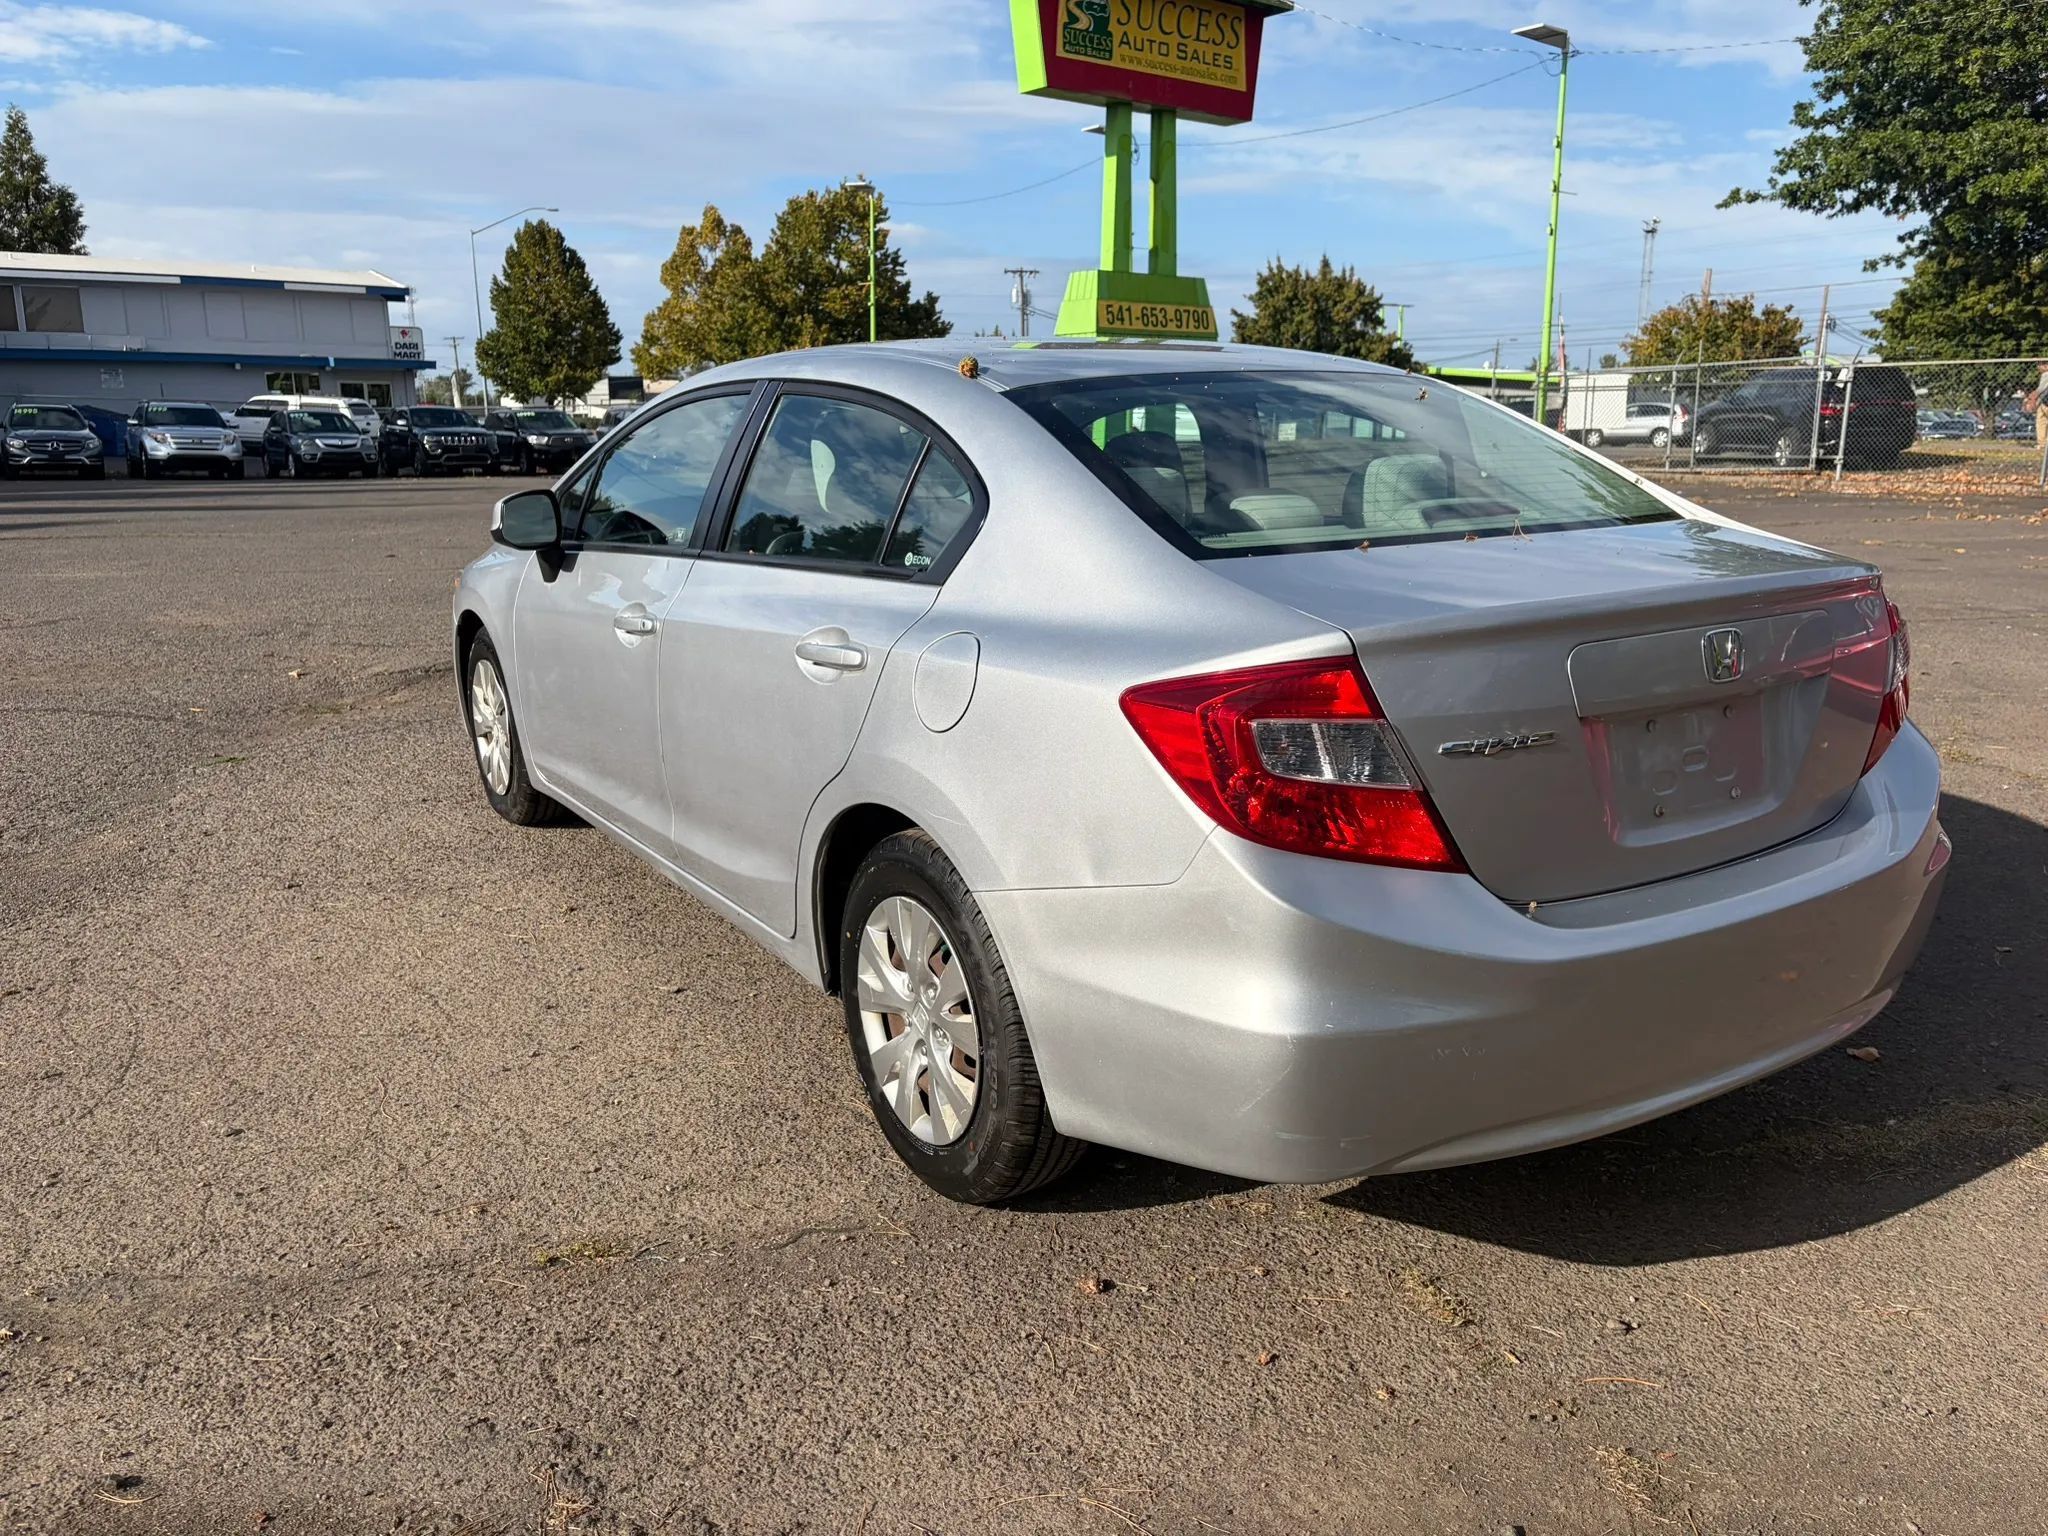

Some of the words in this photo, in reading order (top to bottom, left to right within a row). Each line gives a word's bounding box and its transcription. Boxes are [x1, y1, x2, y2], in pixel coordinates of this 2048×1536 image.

[1116, 0, 1242, 49] SUCCESS
[1064, 28, 1112, 51] SUCCESS
[1065, 43, 1086, 55] AUTO
[1086, 47, 1110, 58] SALES
[1118, 31, 1170, 57] AUTO
[1176, 43, 1233, 70] SALES
[1105, 304, 1210, 330] 541-653-9790
[393, 351, 422, 359] MART
[394, 342, 419, 350] DARI
[912, 555, 932, 565] ECON
